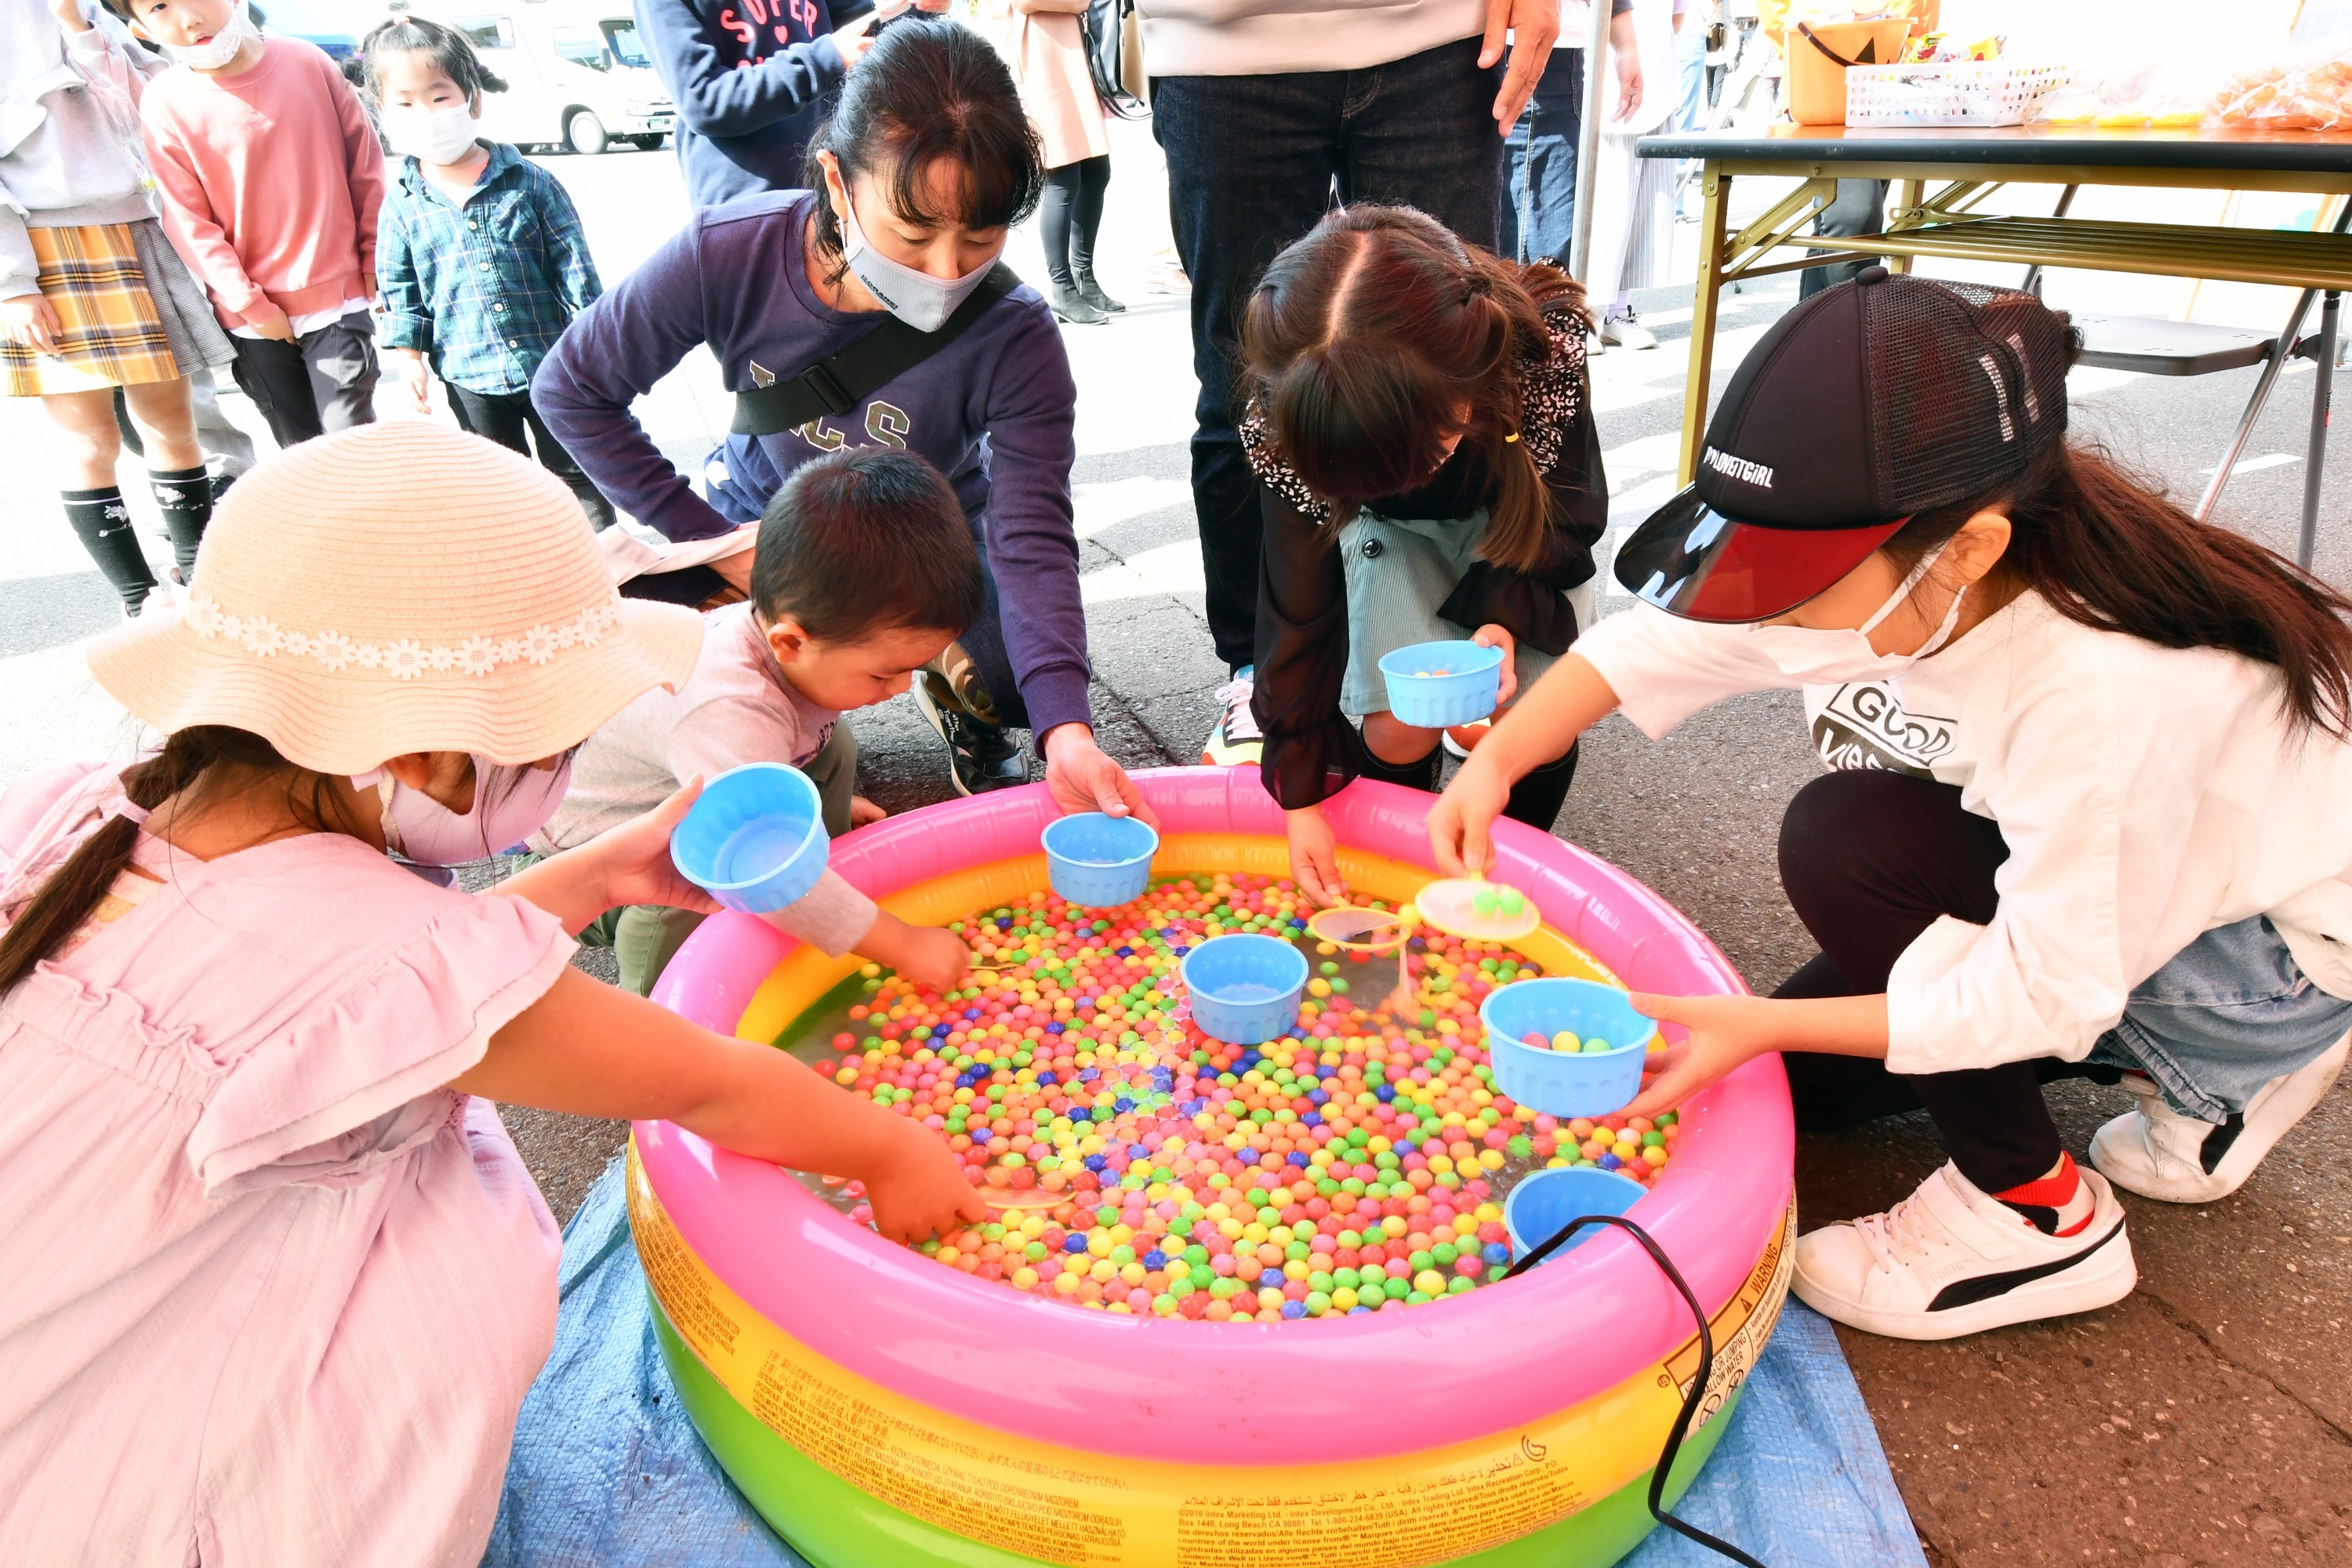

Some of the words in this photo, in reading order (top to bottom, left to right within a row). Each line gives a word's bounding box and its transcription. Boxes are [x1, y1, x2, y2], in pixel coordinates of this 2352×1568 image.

[1751, 1243, 1778, 1294] WARNING
[1715, 1356, 1726, 1371] OR
[1725, 1332, 1747, 1363] JUMPING
[1726, 1351, 1744, 1376] WATER
[1658, 1376, 1670, 1387] US
[852, 1428, 862, 1438] BEZ
[862, 1433, 887, 1450] NADZORU
[891, 1444, 913, 1460] RYZYKO
[967, 1473, 985, 1486] TYLKO
[986, 1479, 1000, 1490] POD
[1000, 1483, 1043, 1501] ODPOWIEDNIM
[865, 1446, 874, 1456] BEZ
[876, 1450, 901, 1467] NADZORA
[906, 1462, 934, 1480] OPASNOST
[935, 1474, 944, 1484] OD
[974, 1488, 1002, 1502] KORISTITI
[1039, 1504, 1052, 1515] POD
[1054, 1507, 1089, 1523] NADZOROM
[967, 1497, 982, 1508] CSAK
[1051, 1518, 1078, 1531] MELLETT
[1178, 1508, 1203, 1517] ©2016
[1205, 1509, 1224, 1518] Intex
[1227, 1510, 1265, 1520] Marketing
[1290, 1508, 1308, 1519] Intex
[1311, 1502, 1362, 1520] Development
[1402, 1497, 1420, 1507] Intex
[1423, 1490, 1450, 1504] Trading
[1467, 1482, 1483, 1493] Intex
[1486, 1472, 1523, 1487] Recreation
[1178, 1518, 1193, 1526] Box
[1219, 1520, 1240, 1530] Long
[1241, 1519, 1266, 1528] Beach
[1327, 1509, 1383, 1527] 1-800-234-6839
[1410, 1506, 1421, 1515] All
[1423, 1500, 1444, 1513] rights
[1446, 1489, 1496, 1508] reserved/Tous
[1497, 1482, 1517, 1494] droits
[1178, 1537, 1214, 1545] countries
[1293, 1534, 1321, 1548] license
[1360, 1528, 1393, 1541] Marques
[1429, 1519, 1446, 1530] dans
[1449, 1512, 1478, 1525] certains
[1479, 1508, 1496, 1519] pays
[1498, 1501, 1515, 1511] sous
[1516, 1492, 1540, 1504] licence
[1541, 1481, 1575, 1497] de/Marcas
[1192, 1528, 1229, 1537] derechos
[1295, 1525, 1323, 1538] Rechte
[1326, 1519, 1391, 1537] vorbehalten/Tutti
[1397, 1515, 1417, 1527] diritti
[1468, 1494, 1508, 1511] Trademarks
[1509, 1488, 1527, 1499] used
[1536, 1479, 1555, 1490] some
[1000, 1517, 1045, 1533] KOMPETENTAS
[1046, 1526, 1080, 1541] PERSONAS
[1178, 1545, 1223, 1555] registradas
[1278, 1546, 1310, 1555] algunos
[1340, 1541, 1352, 1551] del
[1354, 1538, 1381, 1550] mundo
[1383, 1536, 1400, 1547] bajo
[1402, 1531, 1431, 1542] licencia
[1495, 1504, 1531, 1519] verwendet
[1344, 1546, 1370, 1558] marchi
